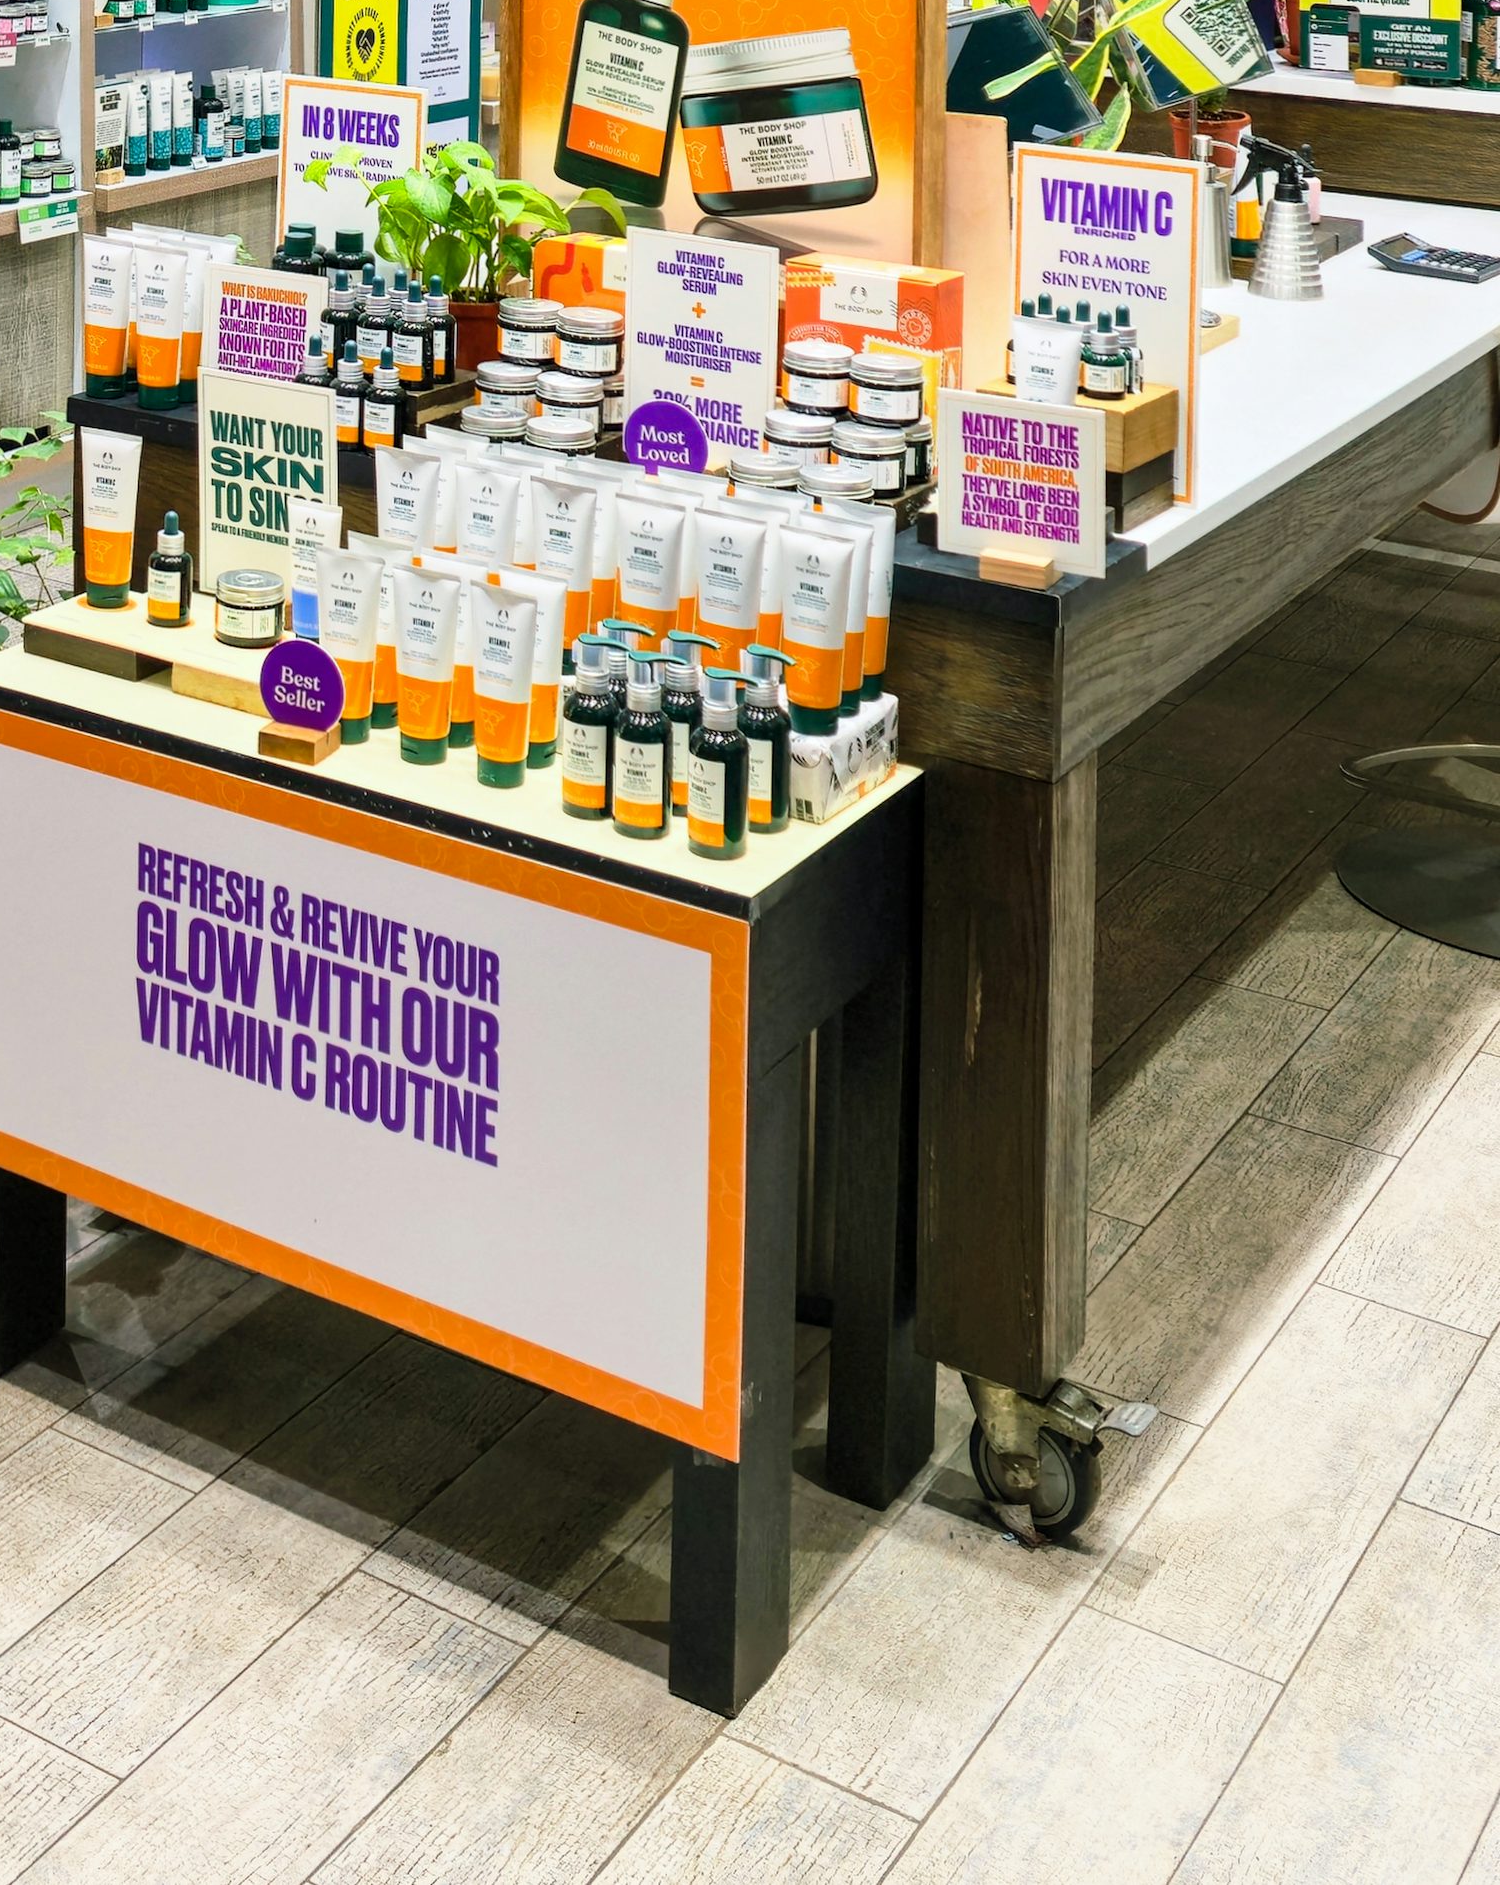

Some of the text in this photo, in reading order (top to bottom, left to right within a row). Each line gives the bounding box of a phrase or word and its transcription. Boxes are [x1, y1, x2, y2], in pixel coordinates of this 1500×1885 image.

[598, 31, 662, 55] THE BODY SHOP
[610, 53, 644, 72] VITAMIN C
[303, 105, 399, 148] IN 8 WEEKS
[740, 121, 806, 135] THE BODY SHOP
[757, 135, 793, 147] VITAMIN C
[1041, 178, 1173, 236] VITAMIN C
[1074, 227, 1136, 240] ENRICHED
[676, 250, 724, 268] VITAMIN C
[1060, 250, 1150, 274] FOR A MORE
[657, 262, 743, 286] GLOW-REVEALING
[683, 280, 717, 295] SERUM
[1043, 271, 1167, 301] SKIN EVEN TONE
[222, 281, 307, 306] WHAT IS BAKUCHIOL?
[220, 297, 306, 327] A PLANT-BASED
[219, 317, 306, 342] SKINCARE INGREDIENT
[674, 325, 723, 343] VITAMIN C
[219, 332, 305, 362] KNOWN FOR ITS
[637, 332, 762, 364] GLOW-BOOSTING INTENSE
[665, 351, 732, 373] MOISTURISER
[696, 397, 742, 424] MORE
[210, 410, 322, 460] WANT YOUR
[640, 425, 685, 445] Most
[962, 412, 1078, 450] NATIVE TO THE
[637, 444, 690, 464] Loved
[962, 436, 1079, 469] TROPICAL FORESTS
[211, 447, 323, 494] SKIN
[965, 455, 1077, 490] OF SOUTH AMERICA,
[212, 479, 242, 522] TO
[962, 474, 1079, 509] THEY'VE LONG BEEN
[281, 666, 321, 691] Best
[274, 686, 325, 713] Seller
[138, 843, 500, 1006] REFRESH & REVIVE YOUR
[137, 901, 500, 1092] GLOW WITH OUR
[136, 978, 498, 1168] VITAMIN C ROUTINE
